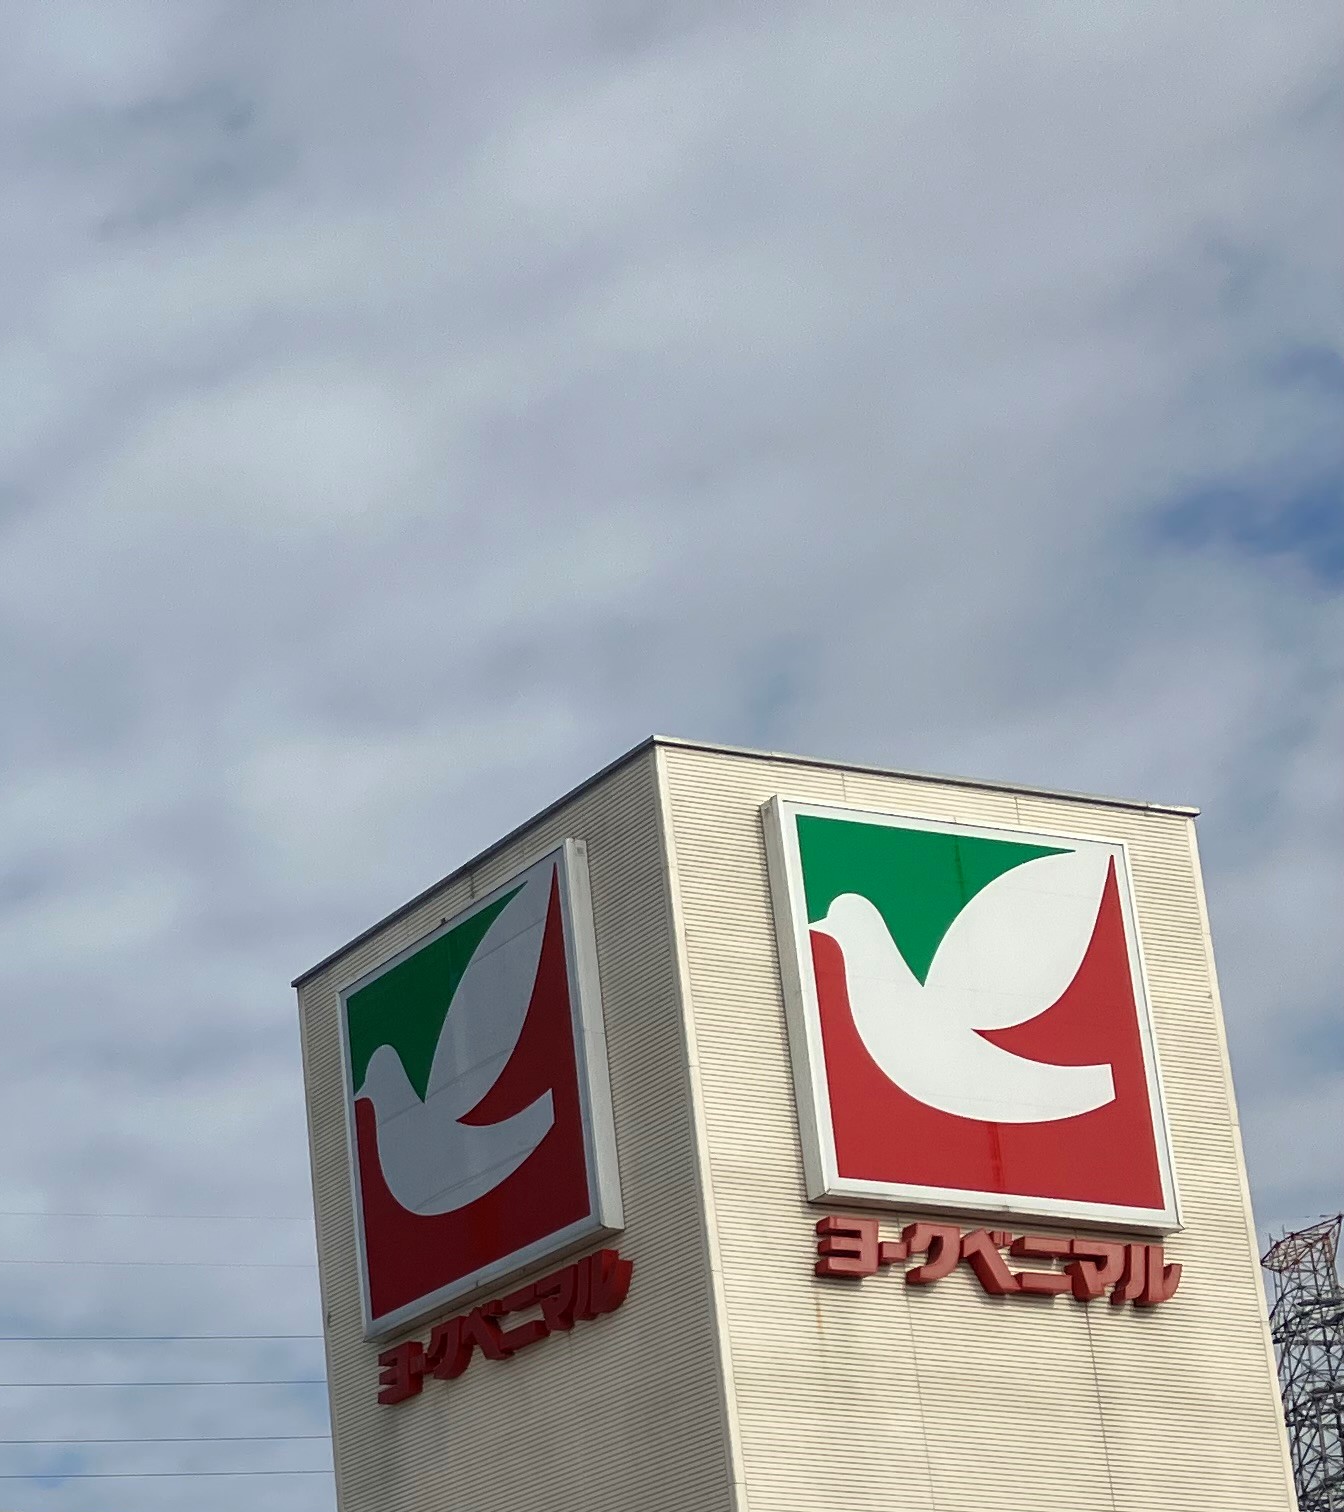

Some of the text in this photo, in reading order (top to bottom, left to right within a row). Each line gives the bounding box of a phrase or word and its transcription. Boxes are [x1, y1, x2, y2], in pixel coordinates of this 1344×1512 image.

[815, 1215, 1182, 1307] ヨークベニマル
[377, 1249, 634, 1405] ヨークベニマル
